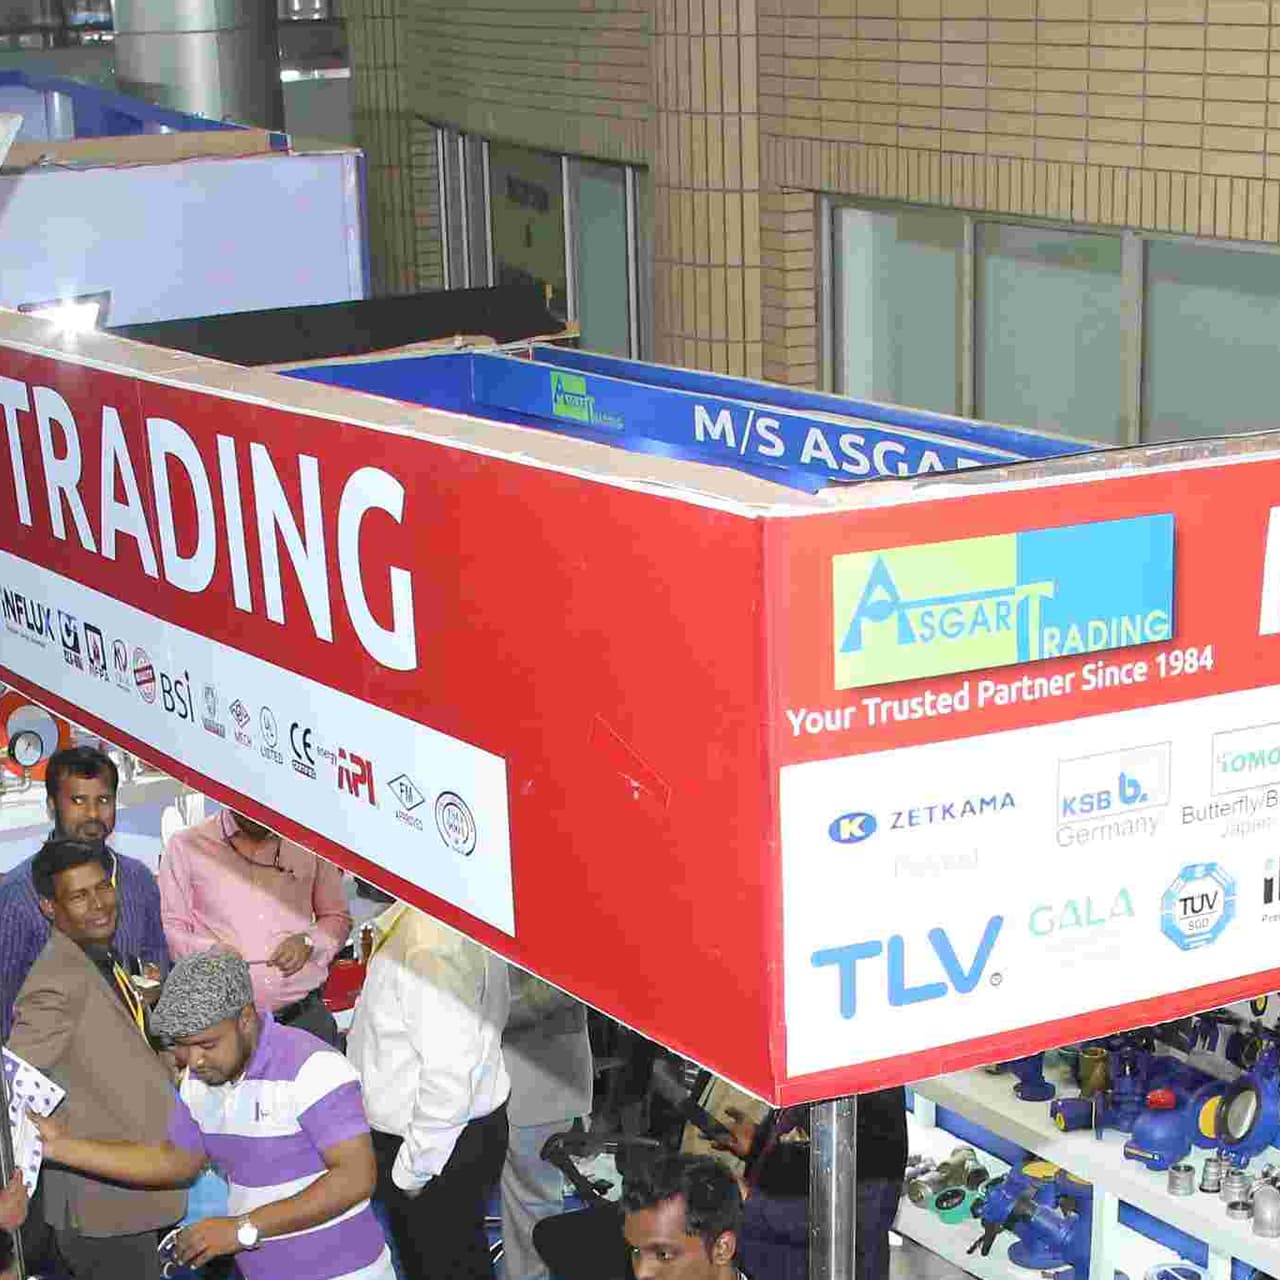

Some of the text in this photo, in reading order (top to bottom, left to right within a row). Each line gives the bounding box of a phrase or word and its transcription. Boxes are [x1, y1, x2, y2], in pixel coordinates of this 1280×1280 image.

[693, 404, 985, 482] M/S ASGA
[788, 645, 1214, 737] Your Trusted Partner Since 1984
[338, 747, 376, 806] API
[1062, 790, 1111, 818] KSB
[889, 792, 1016, 831] ZETKAMA
[1028, 887, 1135, 936] GALA
[811, 916, 1003, 1020] TLV
